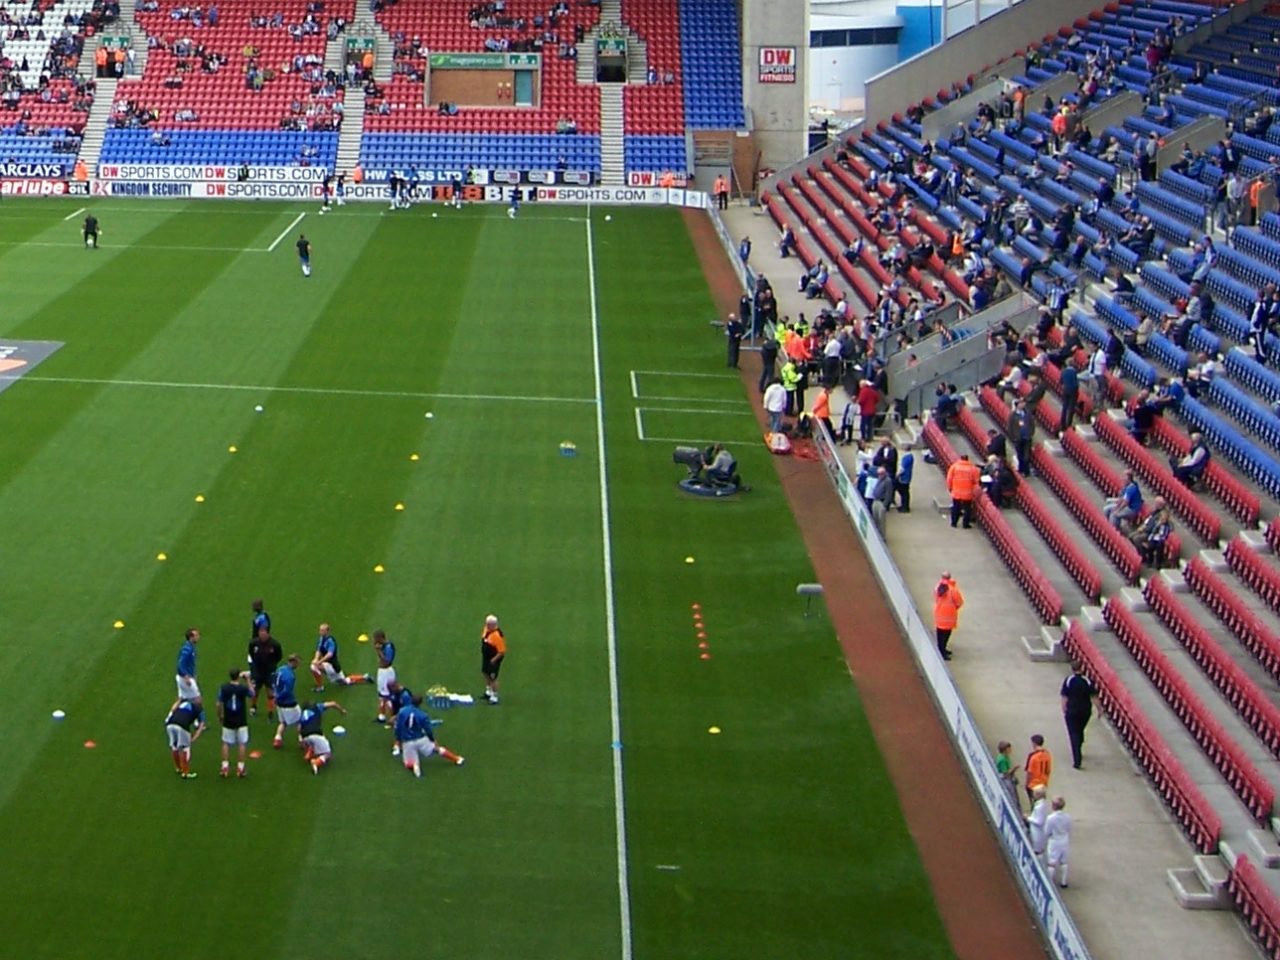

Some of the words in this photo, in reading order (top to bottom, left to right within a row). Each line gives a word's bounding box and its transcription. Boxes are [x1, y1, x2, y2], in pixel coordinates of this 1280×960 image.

[764, 49, 791, 64] DW
[630, 173, 653, 185] DW
[68, 186, 88, 195] OIL
[111, 182, 150, 196] KINGDOM
[151, 183, 193, 196] SECURITY
